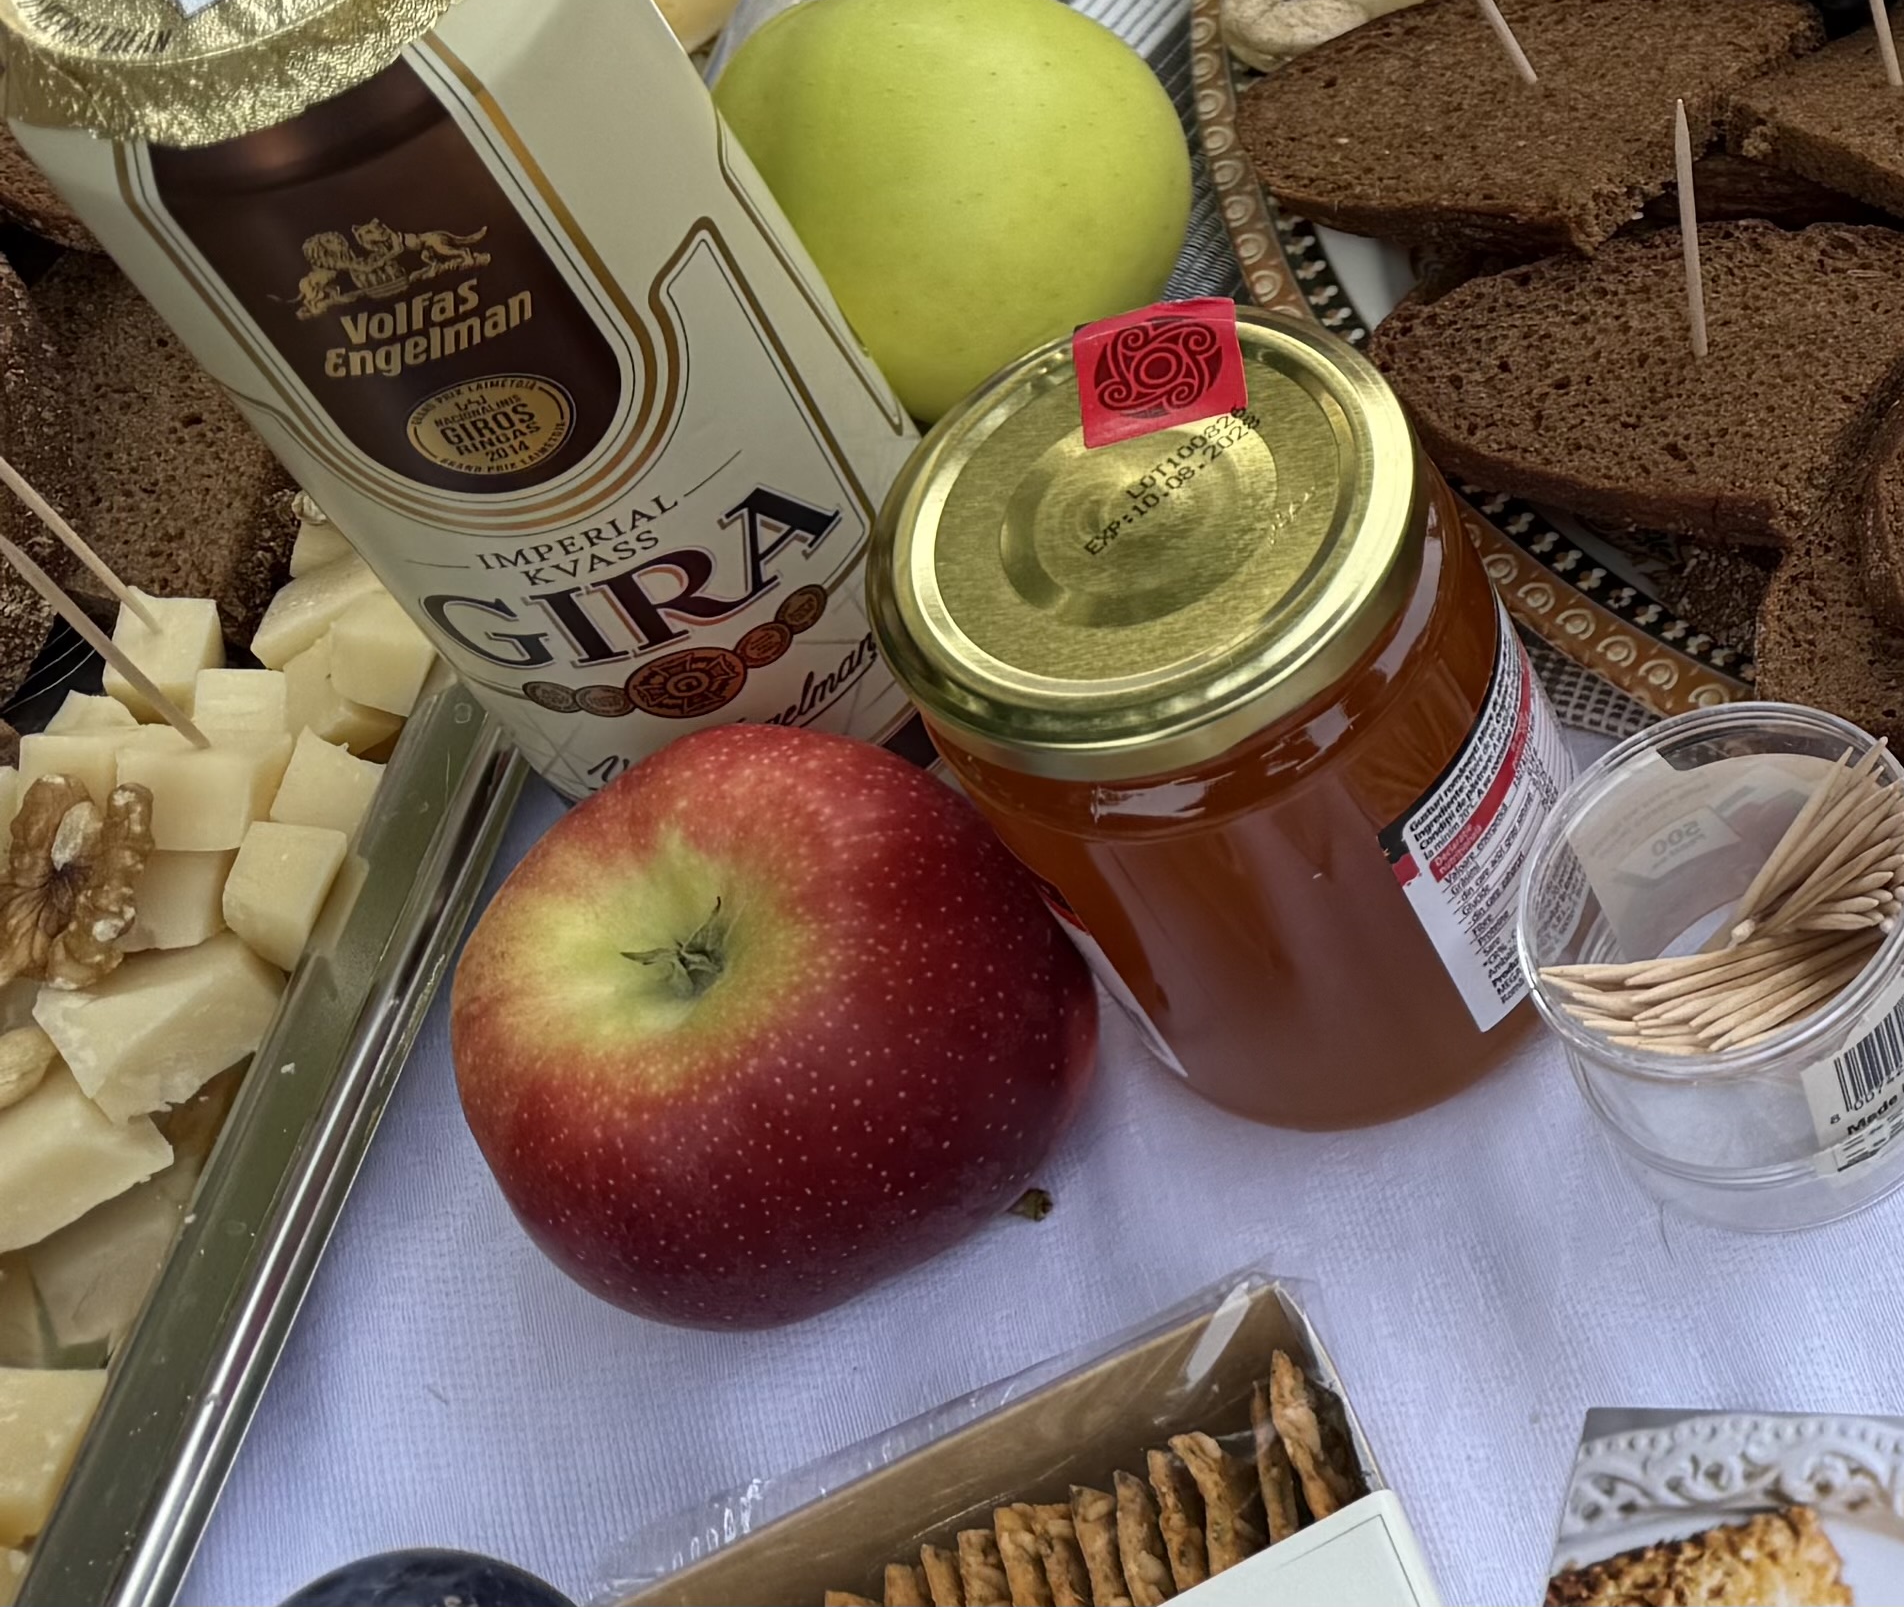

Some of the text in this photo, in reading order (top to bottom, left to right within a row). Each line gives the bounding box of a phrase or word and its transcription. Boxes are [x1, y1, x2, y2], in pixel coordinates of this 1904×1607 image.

[438, 400, 536, 449] GIROS
[484, 437, 531, 464] 2014
[474, 491, 681, 575] IMPERIAL
[519, 524, 662, 591] KVASS
[419, 481, 844, 675] GIRA
[1406, 792, 1445, 834] Gusturi
[1411, 778, 1469, 843] Ingrediente:
[1844, 1093, 1900, 1136] Made
